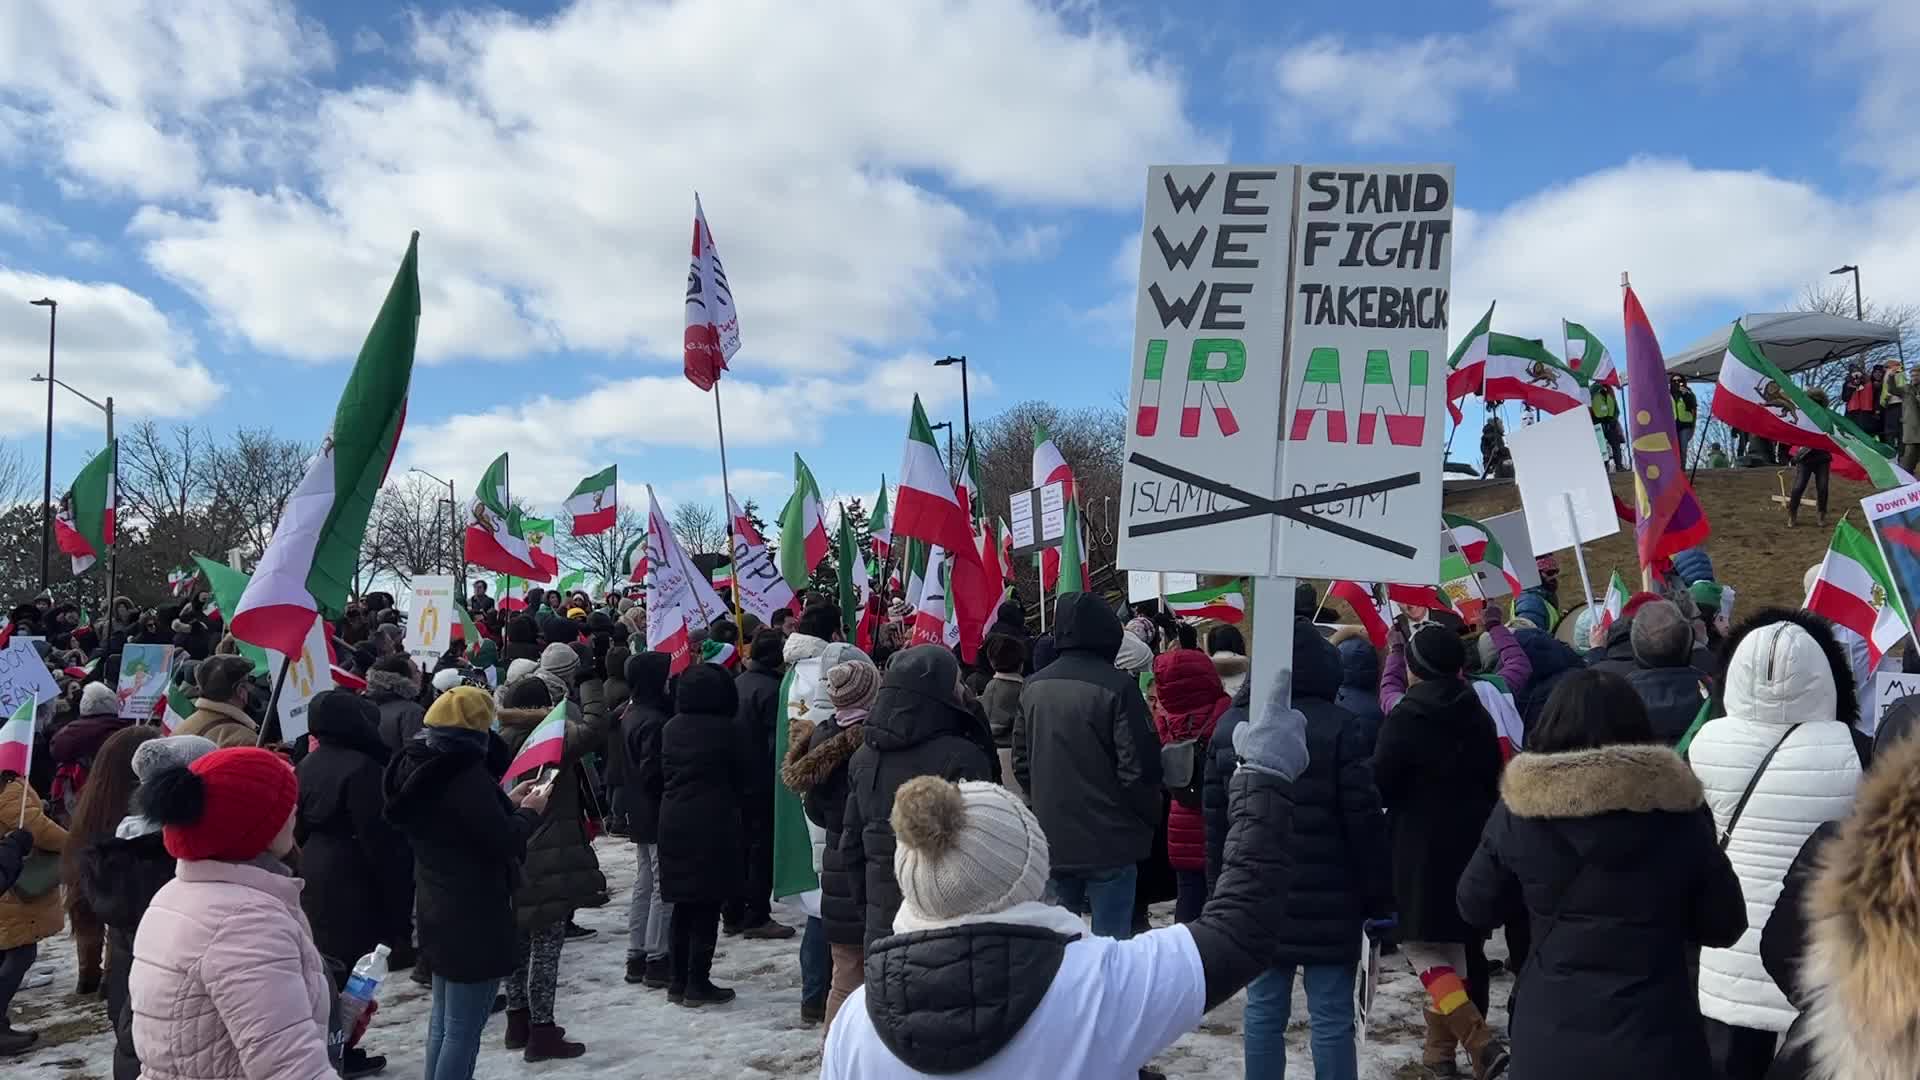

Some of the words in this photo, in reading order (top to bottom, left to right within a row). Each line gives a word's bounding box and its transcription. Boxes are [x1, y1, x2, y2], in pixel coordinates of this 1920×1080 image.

[1164, 171, 1277, 215] WE
[1307, 171, 1449, 214] STAND
[1152, 223, 1267, 271] WE
[1304, 220, 1451, 270] FIGHT
[1148, 280, 1254, 330] WE
[1299, 283, 1449, 330] TAKEBACK
[1129, 481, 1232, 517] ISLAMIC
[1876, 498, 1907, 512] Down
